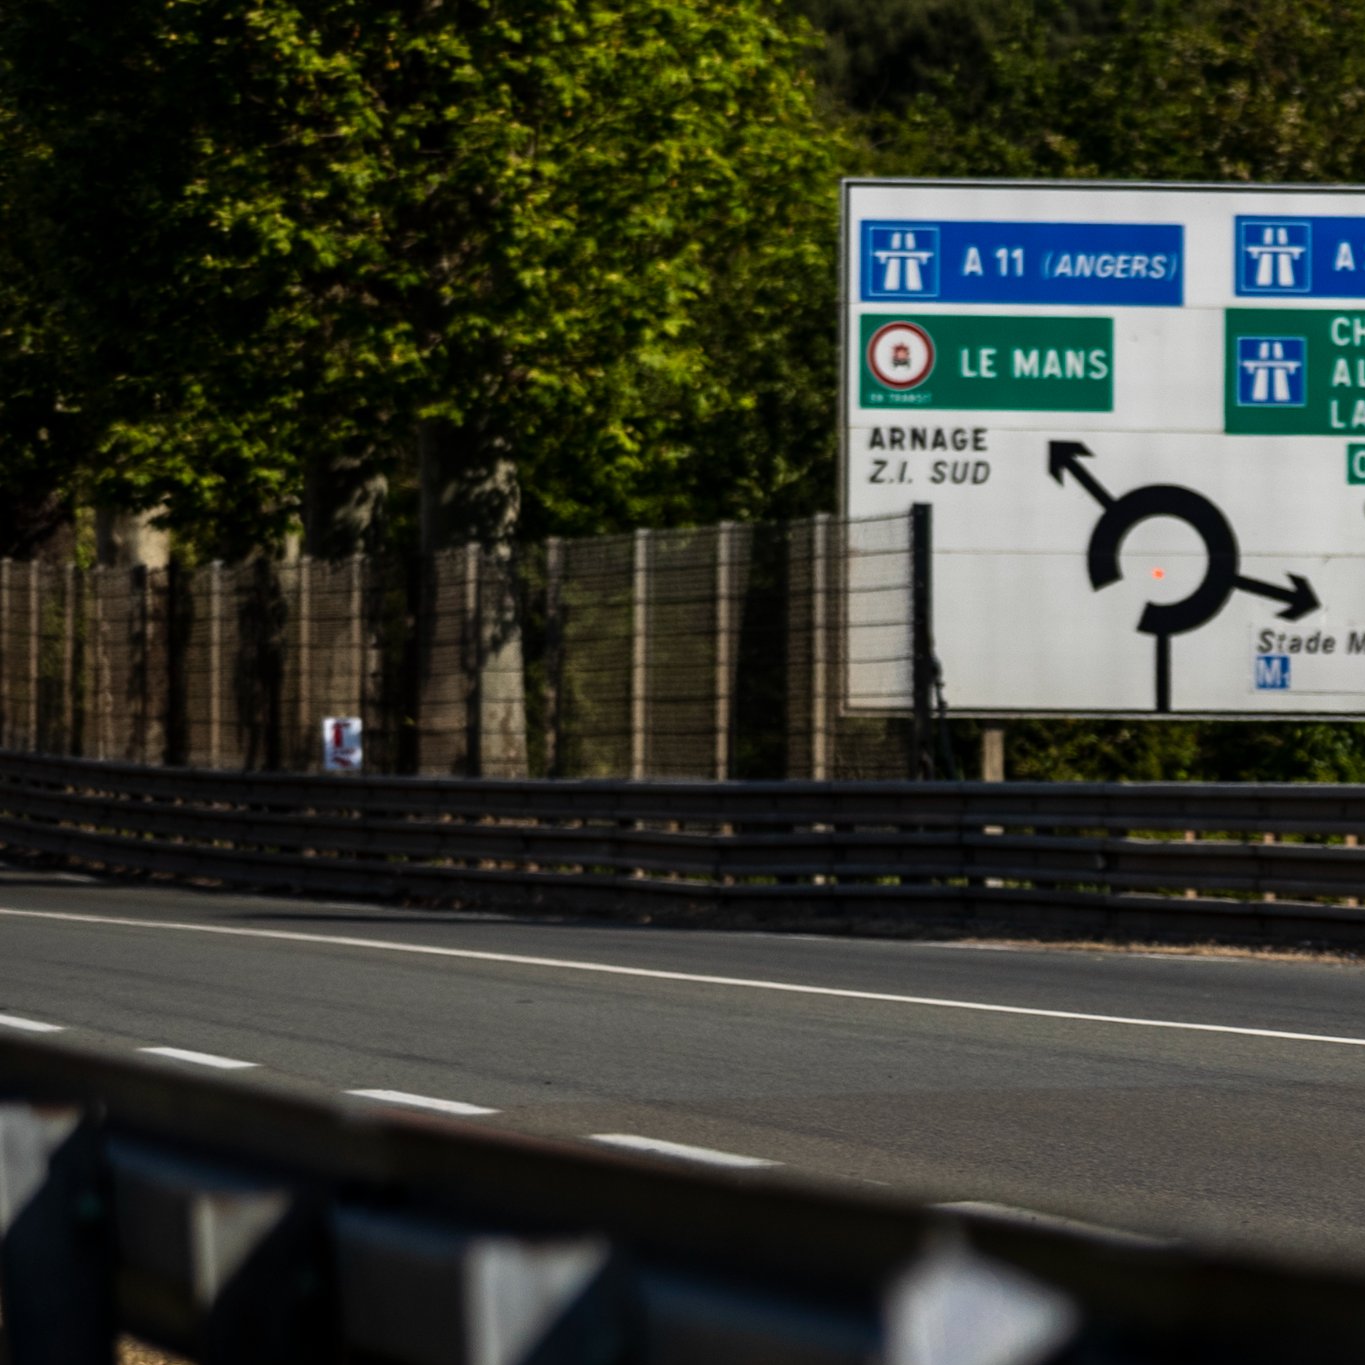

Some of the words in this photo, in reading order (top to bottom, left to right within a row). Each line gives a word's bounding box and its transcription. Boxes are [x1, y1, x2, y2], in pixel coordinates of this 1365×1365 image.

[963, 247, 983, 276] A
[995, 247, 1024, 277] 11
[1043, 253, 1177, 280] (ANGERS)
[1334, 242, 1355, 272] A
[961, 348, 997, 379] LE
[1013, 349, 1109, 380] MANS
[868, 427, 989, 451] ARNAGE
[868, 460, 914, 484] Z.I.
[929, 460, 991, 485] SUD
[1256, 629, 1336, 655] Stade
